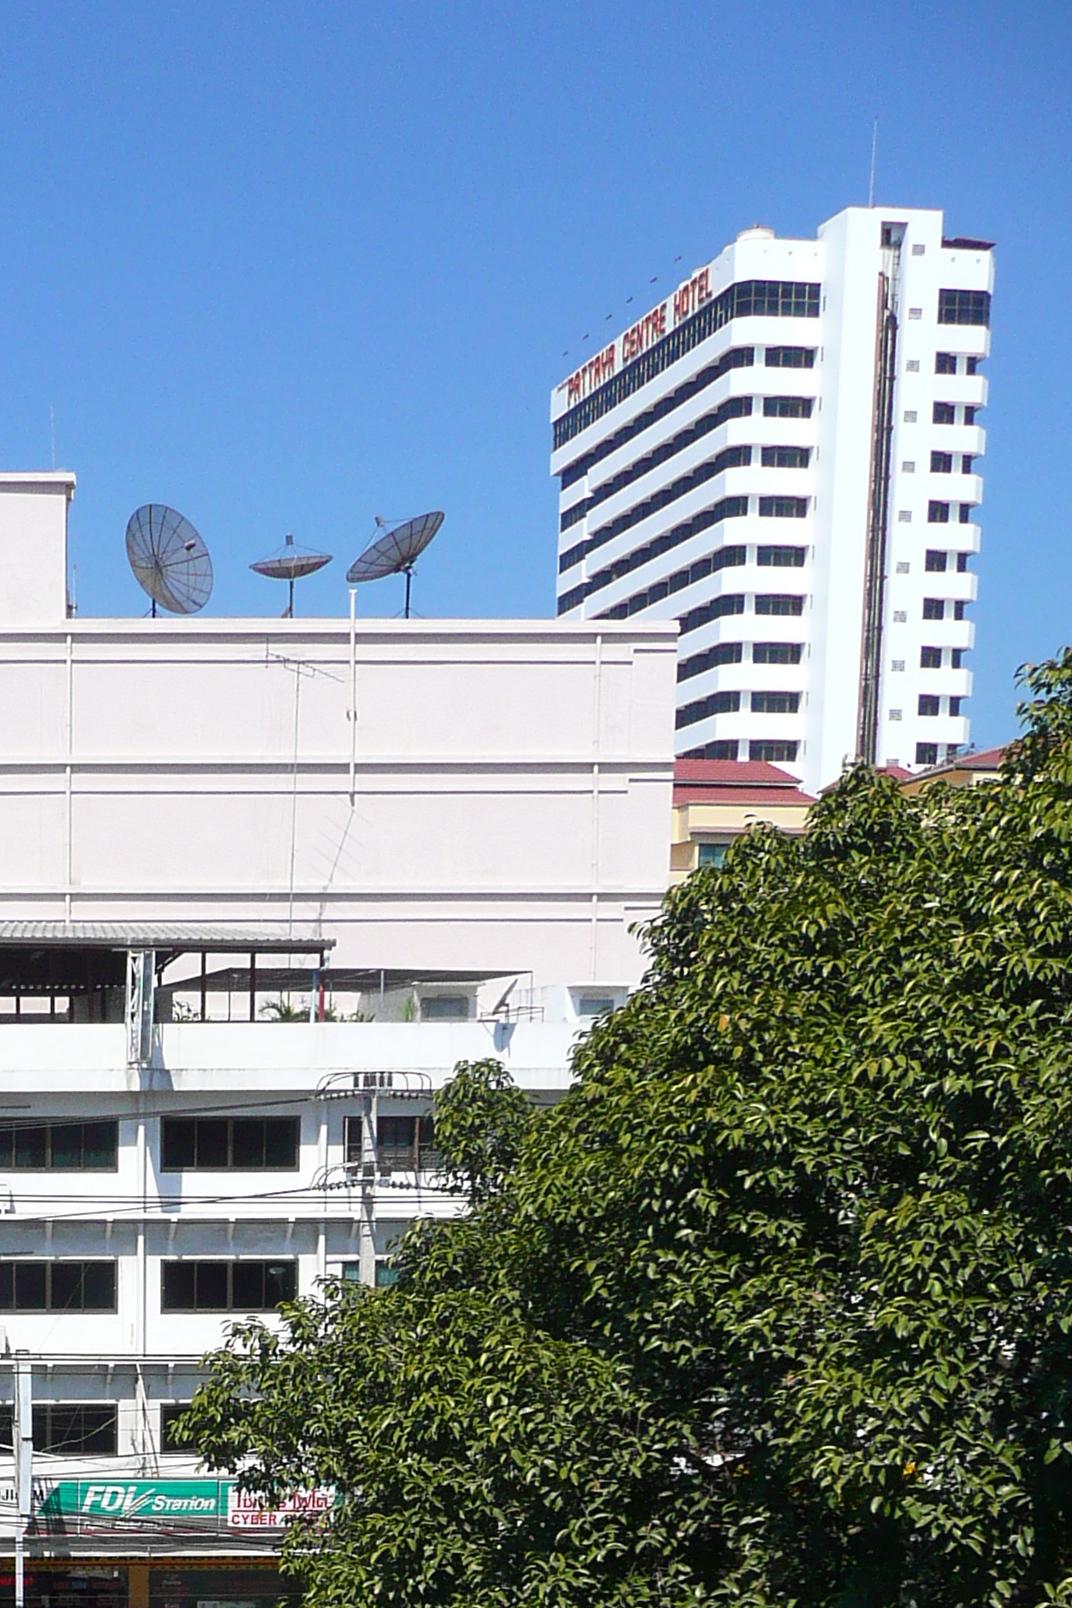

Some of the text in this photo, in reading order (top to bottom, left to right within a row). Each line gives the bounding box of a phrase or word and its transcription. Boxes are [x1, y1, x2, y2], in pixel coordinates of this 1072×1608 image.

[566, 268, 713, 407] PATTAYA CENTRE HOTEL
[231, 1514, 277, 1525] CYBER
